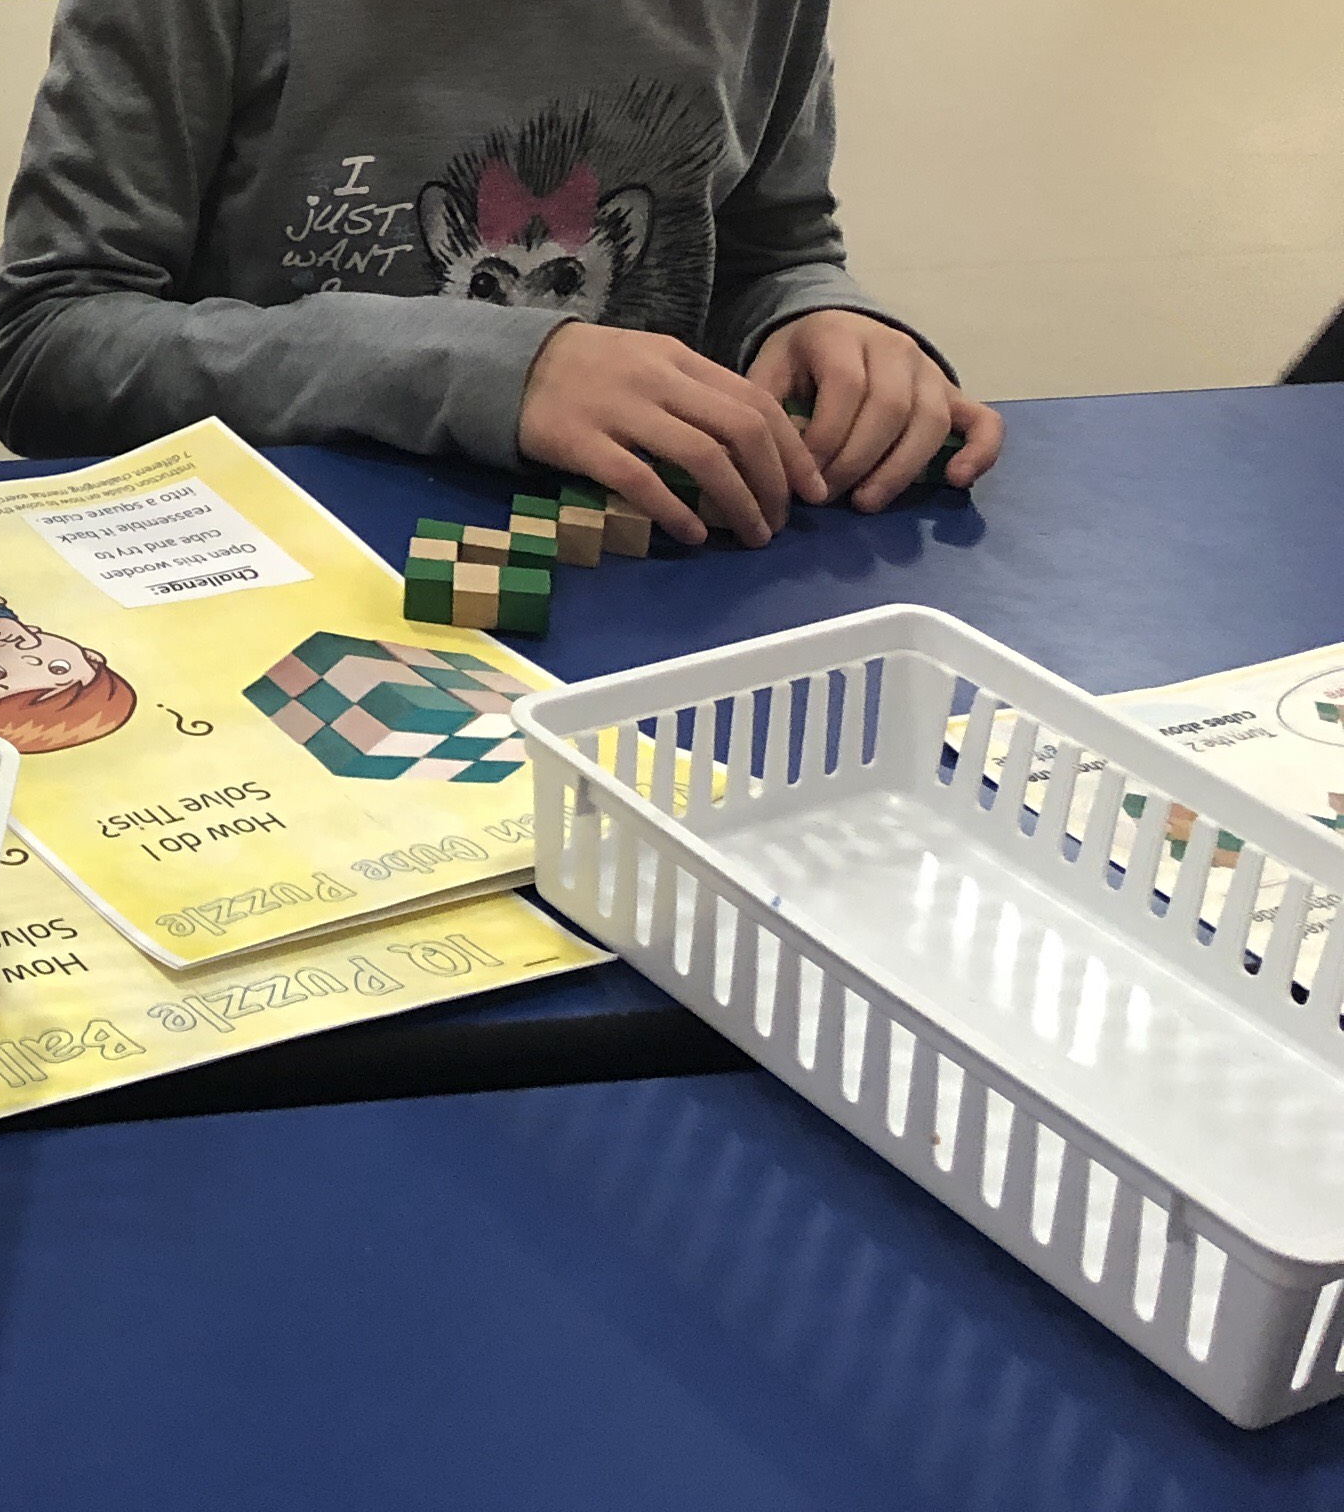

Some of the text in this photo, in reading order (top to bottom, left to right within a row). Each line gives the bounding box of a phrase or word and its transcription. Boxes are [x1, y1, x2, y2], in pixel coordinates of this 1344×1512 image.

[333, 154, 376, 197] I
[83, 499, 144, 520] square
[143, 496, 157, 509] a
[158, 485, 196, 504] into
[56, 503, 214, 545] reassemble it back
[92, 527, 223, 563] cube and try to
[98, 539, 257, 583] Open this wooden
[144, 565, 259, 598] Challenge:
[94, 780, 272, 839] Solve This?
[138, 811, 286, 863] How do I
[350, 833, 490, 890] Cube
[154, 871, 358, 942] Puzzle
[1, 951, 90, 984] How
[385, 933, 504, 979] IQ
[145, 951, 402, 1038] Puzzle
